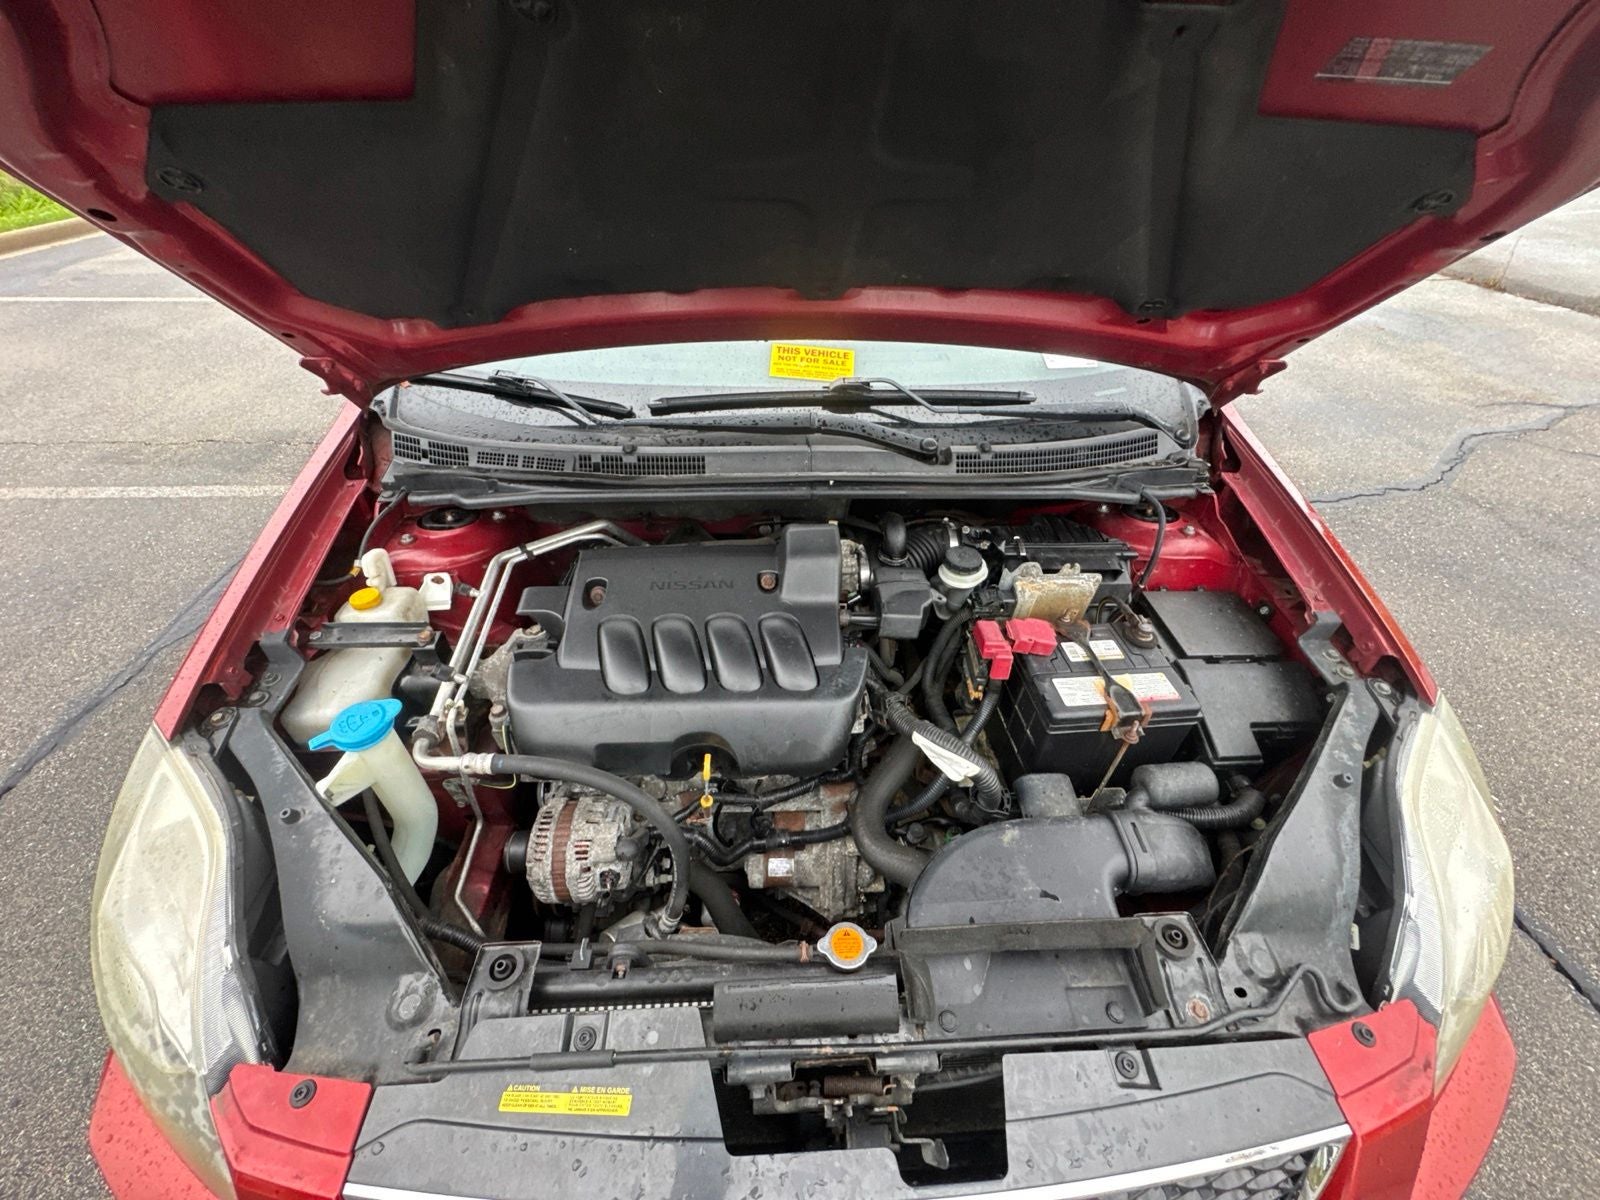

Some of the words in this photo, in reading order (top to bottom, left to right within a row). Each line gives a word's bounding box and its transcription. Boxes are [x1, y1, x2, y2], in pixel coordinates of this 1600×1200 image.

[777, 346, 801, 355] THIS
[804, 348, 850, 360] VEHICLE
[800, 356, 819, 364] FOR
[649, 580, 735, 591] NISSAN
[579, 1086, 596, 1094] MISE
[606, 1087, 631, 1095] GARDE
